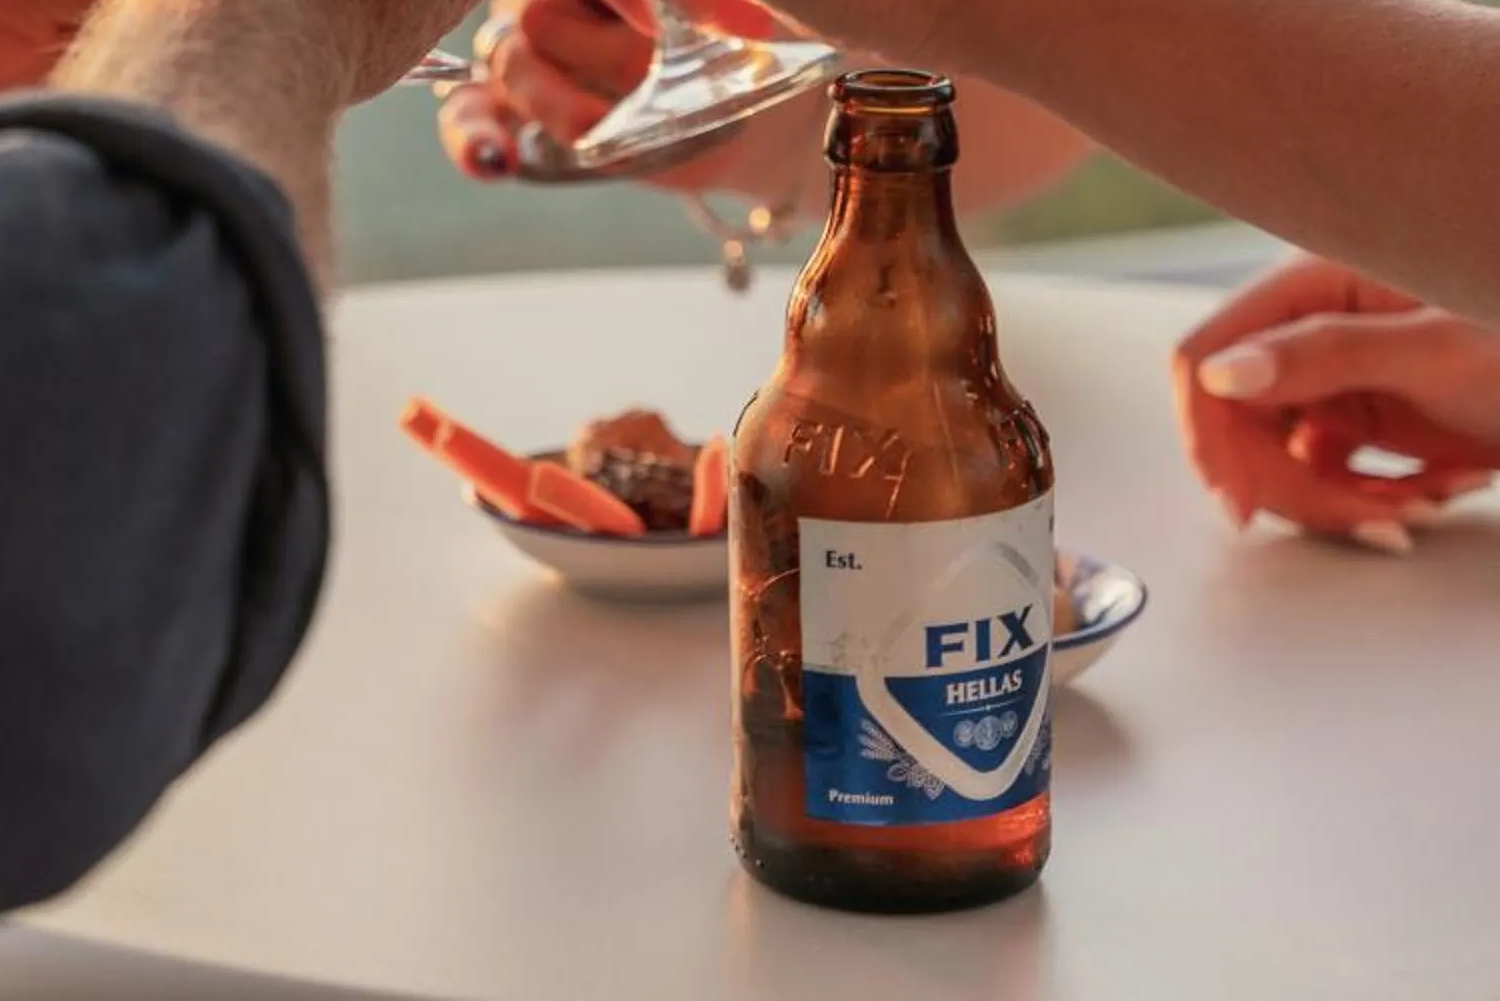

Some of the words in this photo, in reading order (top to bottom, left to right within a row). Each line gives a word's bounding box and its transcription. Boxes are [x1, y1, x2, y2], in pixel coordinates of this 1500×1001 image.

[825, 550, 863, 570] Est.
[924, 603, 1034, 668] FIX
[945, 668, 1023, 705] HELLAS
[828, 789, 895, 806] Premium
